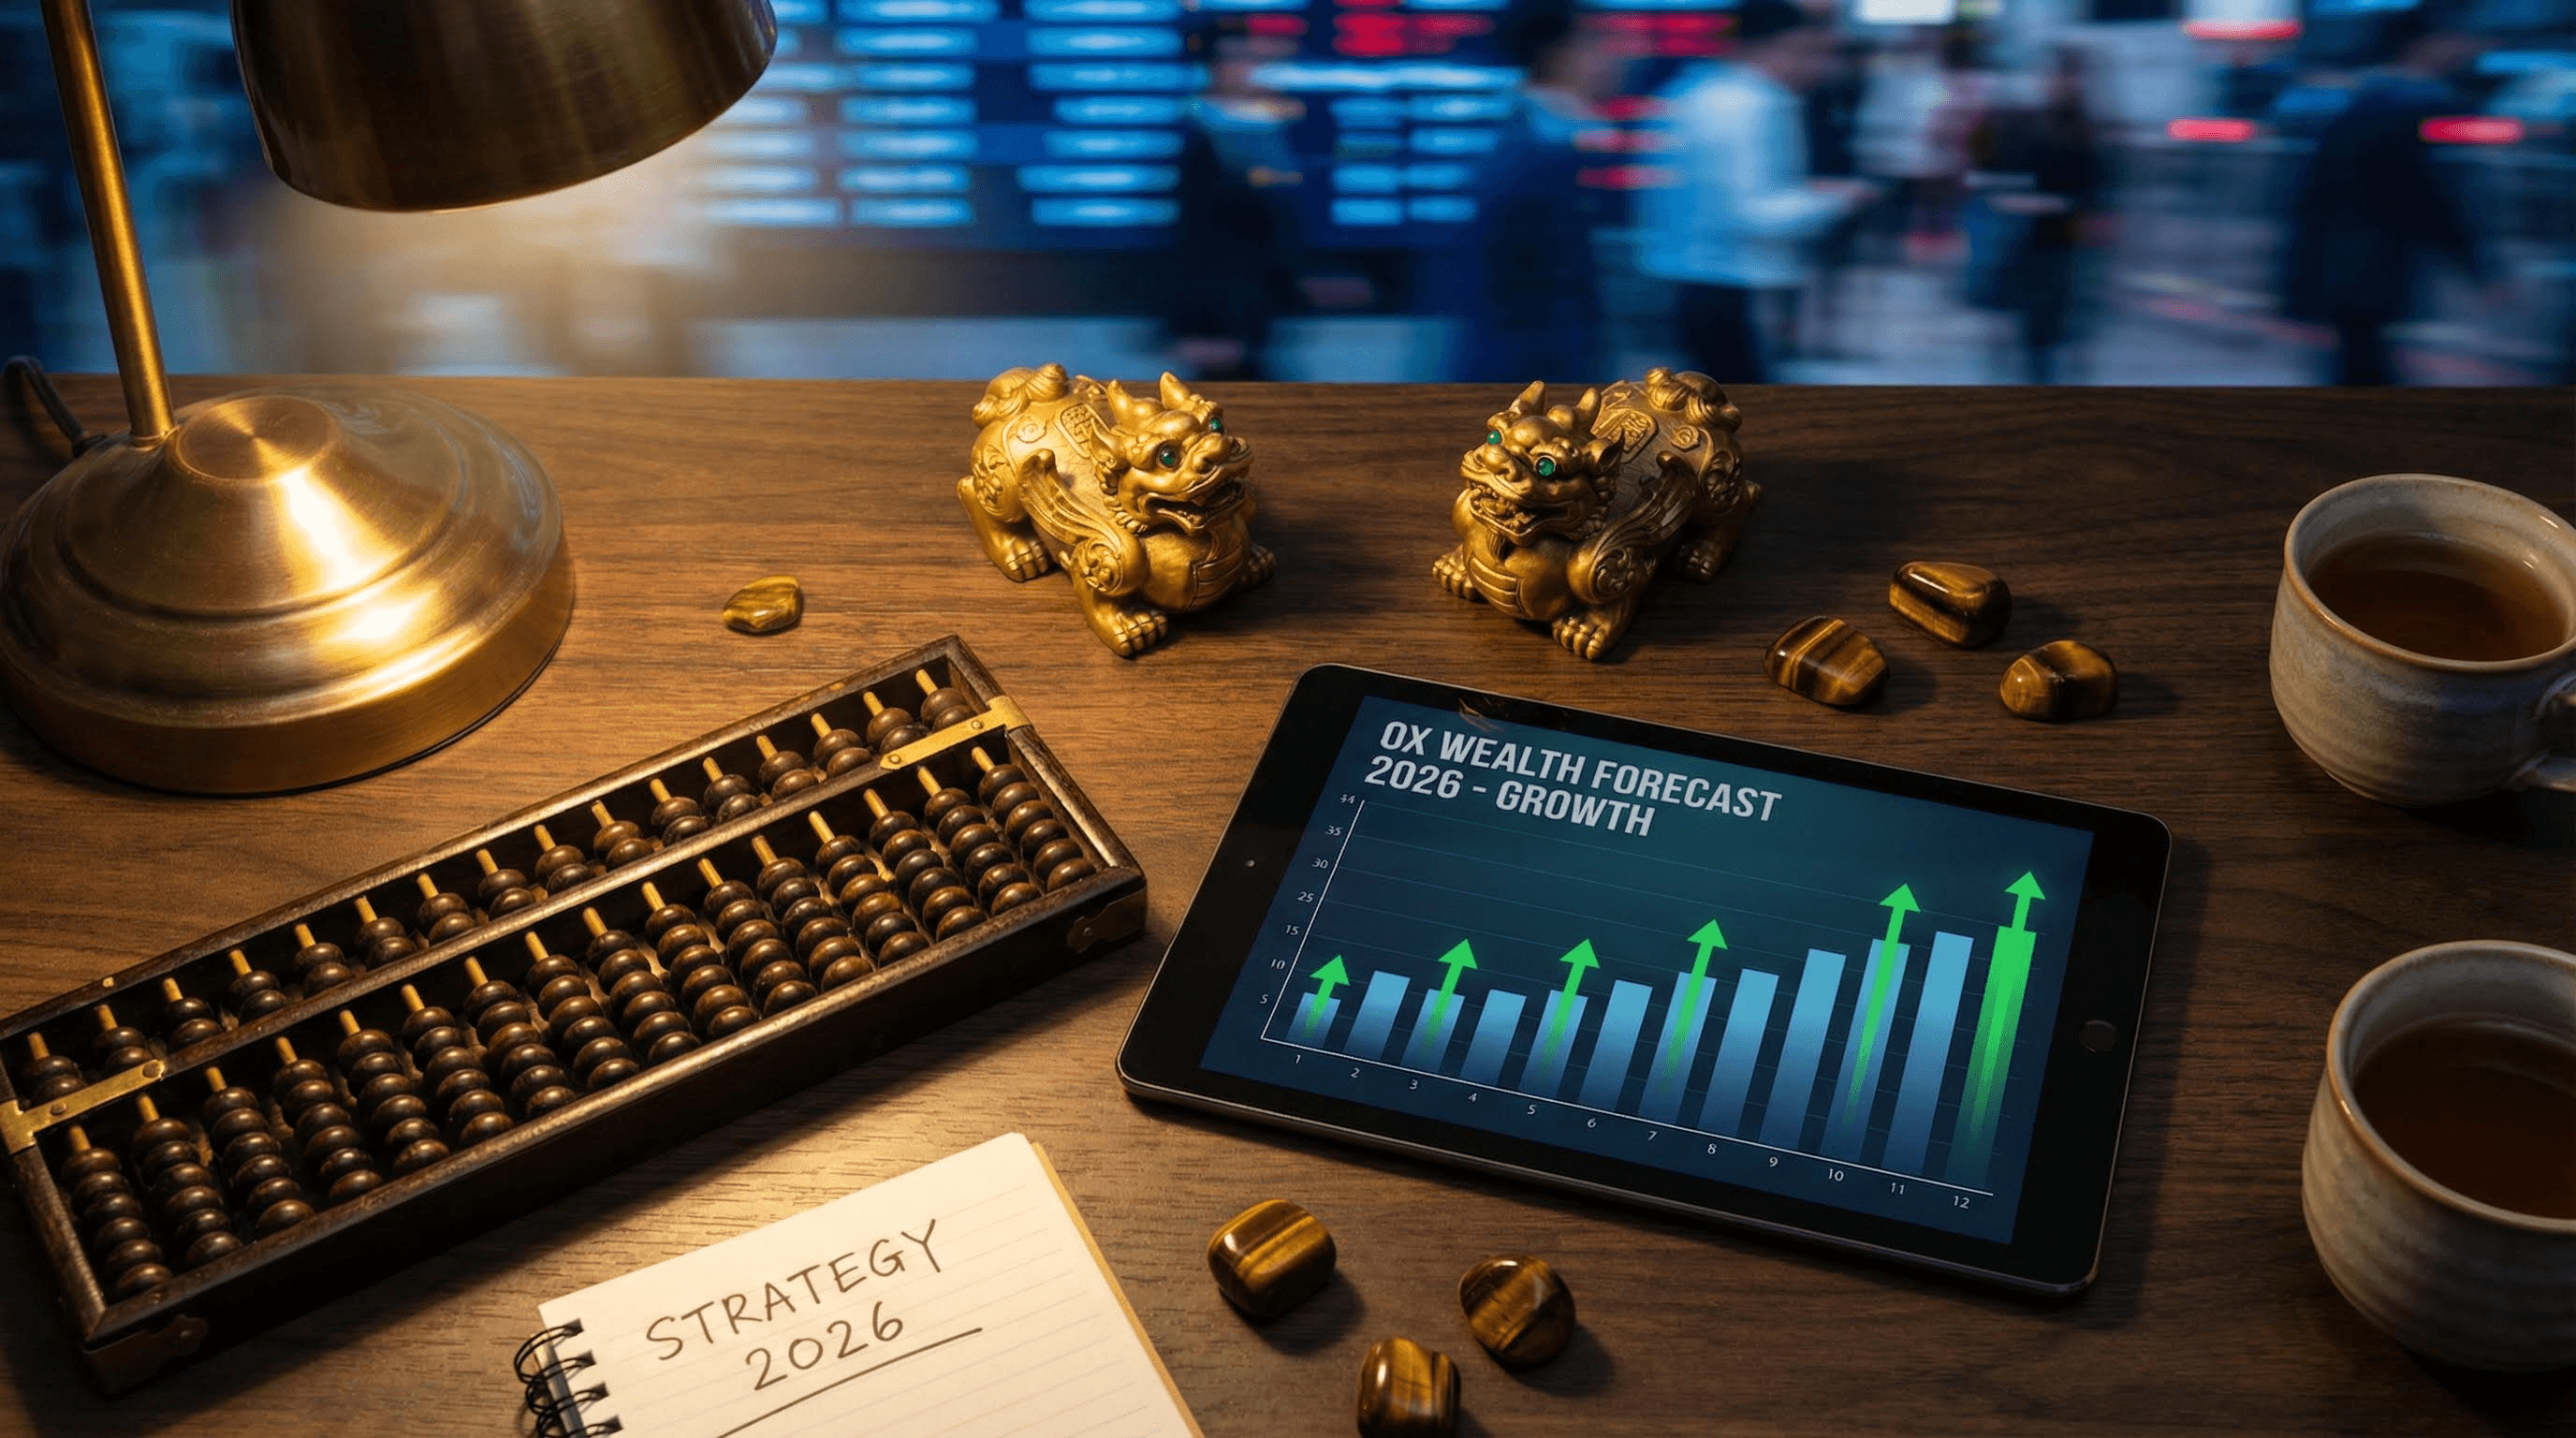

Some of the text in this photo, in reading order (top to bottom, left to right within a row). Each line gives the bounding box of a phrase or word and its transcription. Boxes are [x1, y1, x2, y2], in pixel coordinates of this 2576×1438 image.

[1380, 721, 1782, 822] OX WEALTH FORECAST
[1364, 755, 1464, 799] 2026
[1495, 780, 1659, 837] GROWTH
[1325, 825, 1343, 836] 35
[1311, 858, 1329, 869] 30
[1296, 891, 1315, 903] 25
[1285, 924, 1300, 935] 15
[1270, 958, 1286, 970] 10
[1259, 993, 1269, 1005] 5
[1350, 1067, 1360, 1078] 2
[1409, 1078, 1418, 1090] 3
[1468, 1093, 1477, 1102] 4
[1527, 1104, 1537, 1115] 5
[1587, 1117, 1597, 1128] 6
[1647, 1130, 1658, 1140] 7
[1707, 1143, 1717, 1154] 8
[1769, 1156, 1778, 1167] 9
[1828, 1167, 1845, 1181] 10
[1891, 1181, 1905, 1196] 11
[1954, 1196, 1970, 1210] 12
[646, 1218, 942, 1361] STRATEGY
[745, 1300, 904, 1391] 2026
